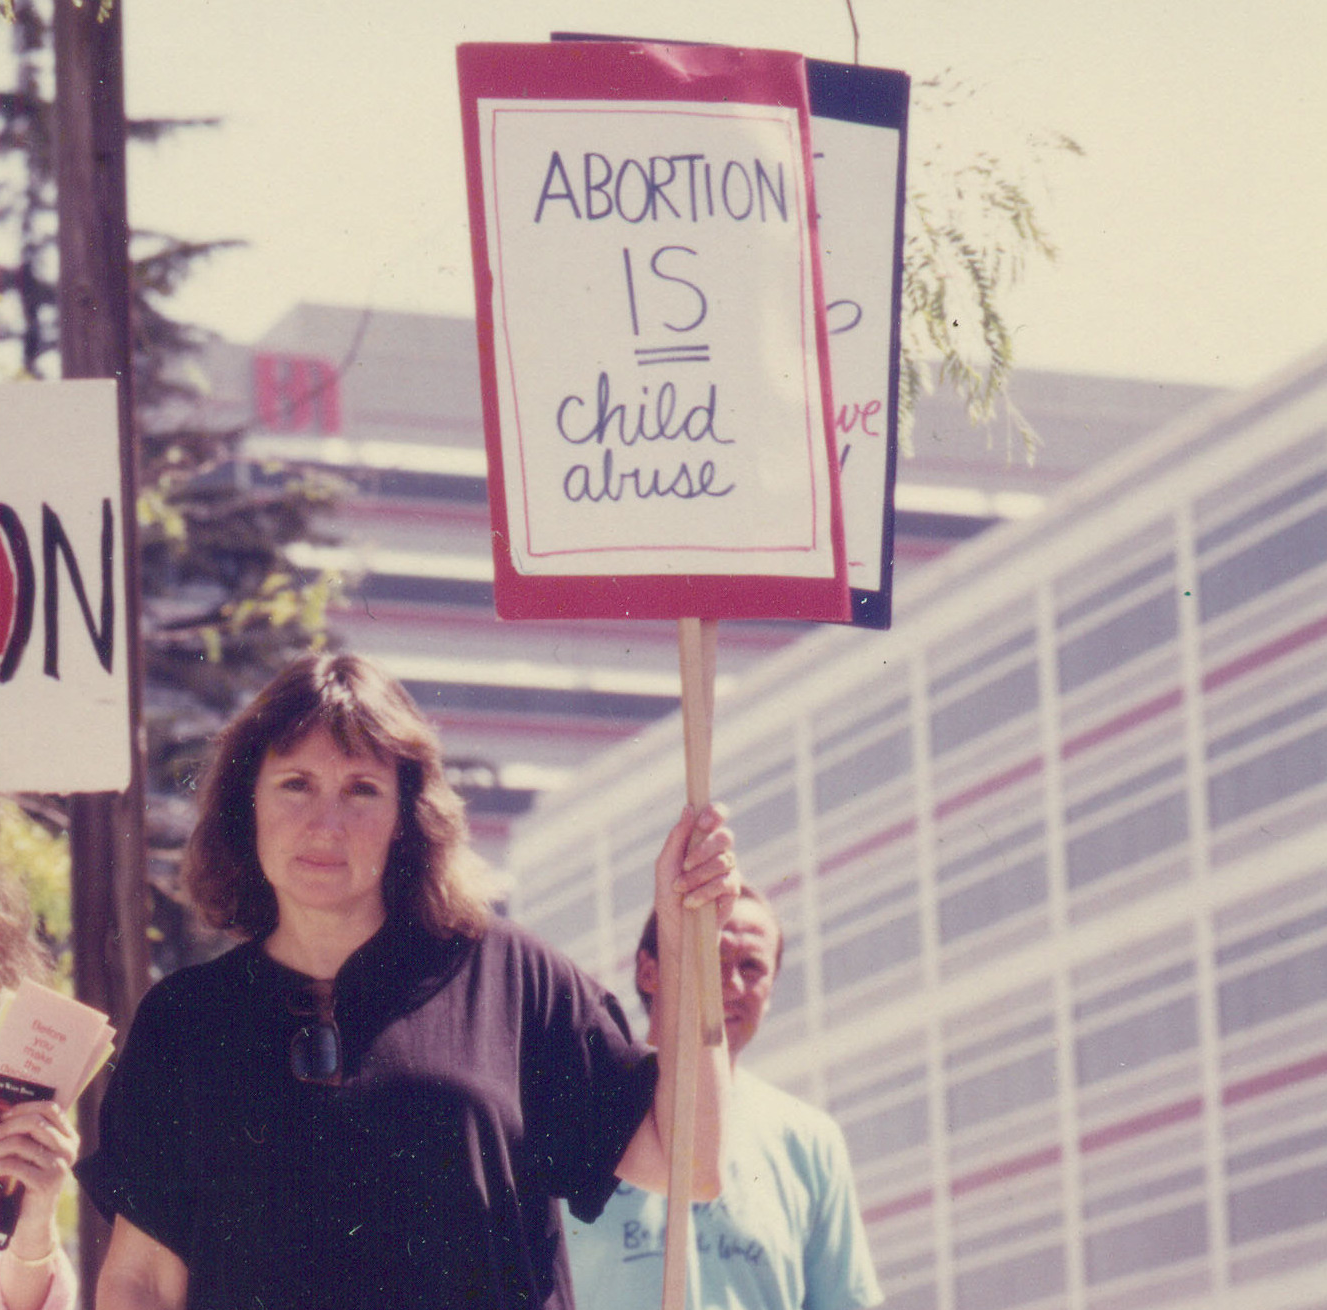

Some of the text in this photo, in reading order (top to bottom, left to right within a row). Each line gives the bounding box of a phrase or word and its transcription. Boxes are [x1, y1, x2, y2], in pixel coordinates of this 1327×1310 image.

[534, 151, 788, 222] ABORTION
[624, 245, 708, 336] IS
[557, 372, 735, 445] child
[564, 448, 736, 502] abuse
